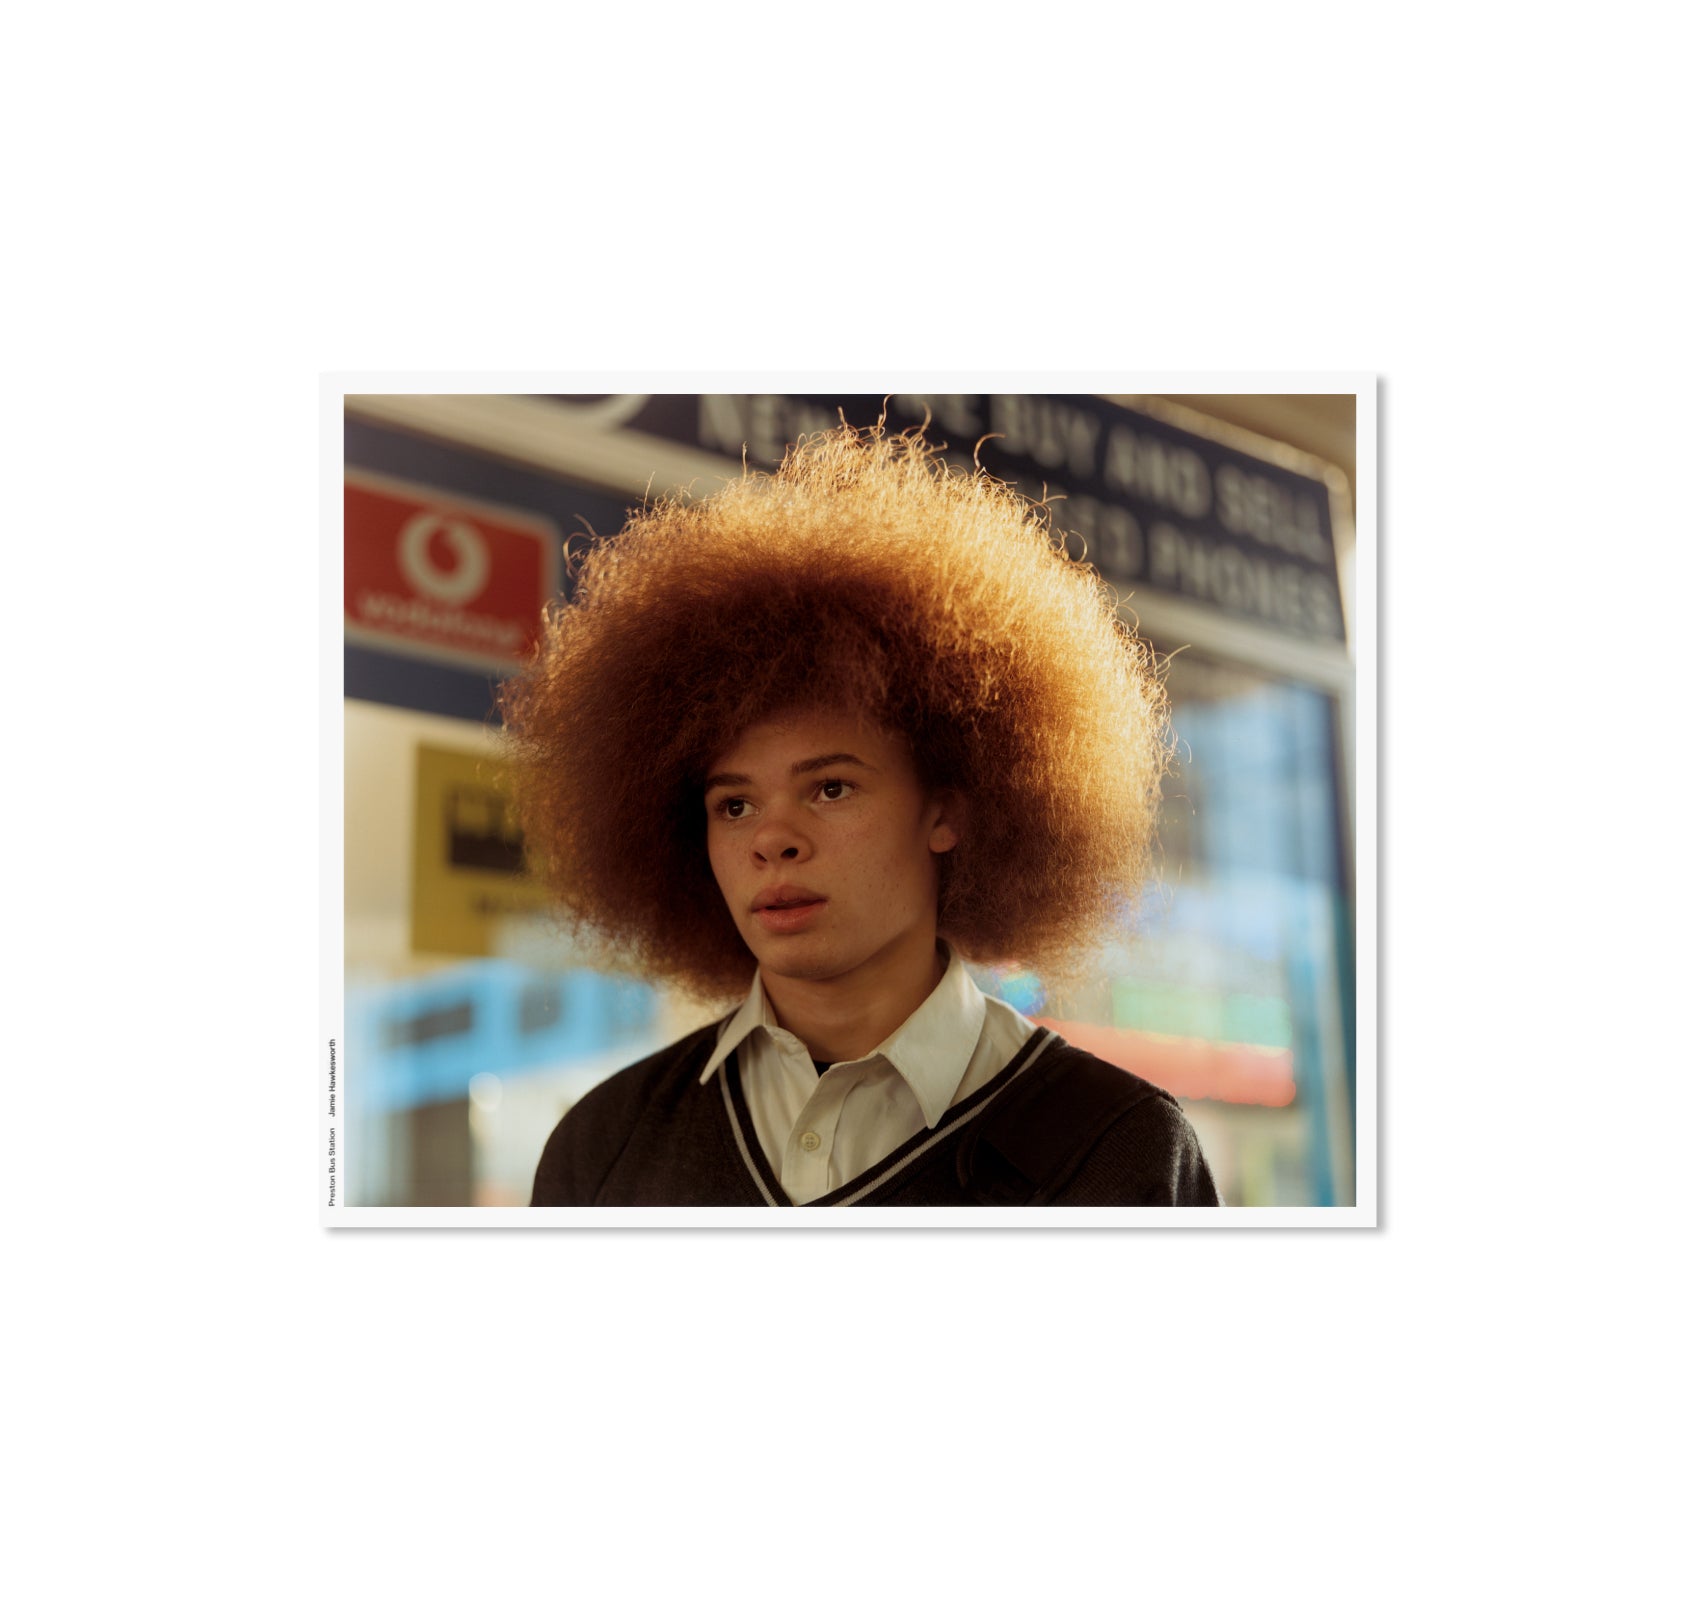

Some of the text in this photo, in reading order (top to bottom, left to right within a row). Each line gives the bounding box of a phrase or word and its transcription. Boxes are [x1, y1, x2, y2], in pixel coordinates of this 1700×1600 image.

[992, 394, 1098, 478] BUY
[1104, 422, 1212, 520] AND
[328, 1038, 336, 1118] Jamie Hawkesworth
[328, 1127, 336, 1207] Preston Bus Station
